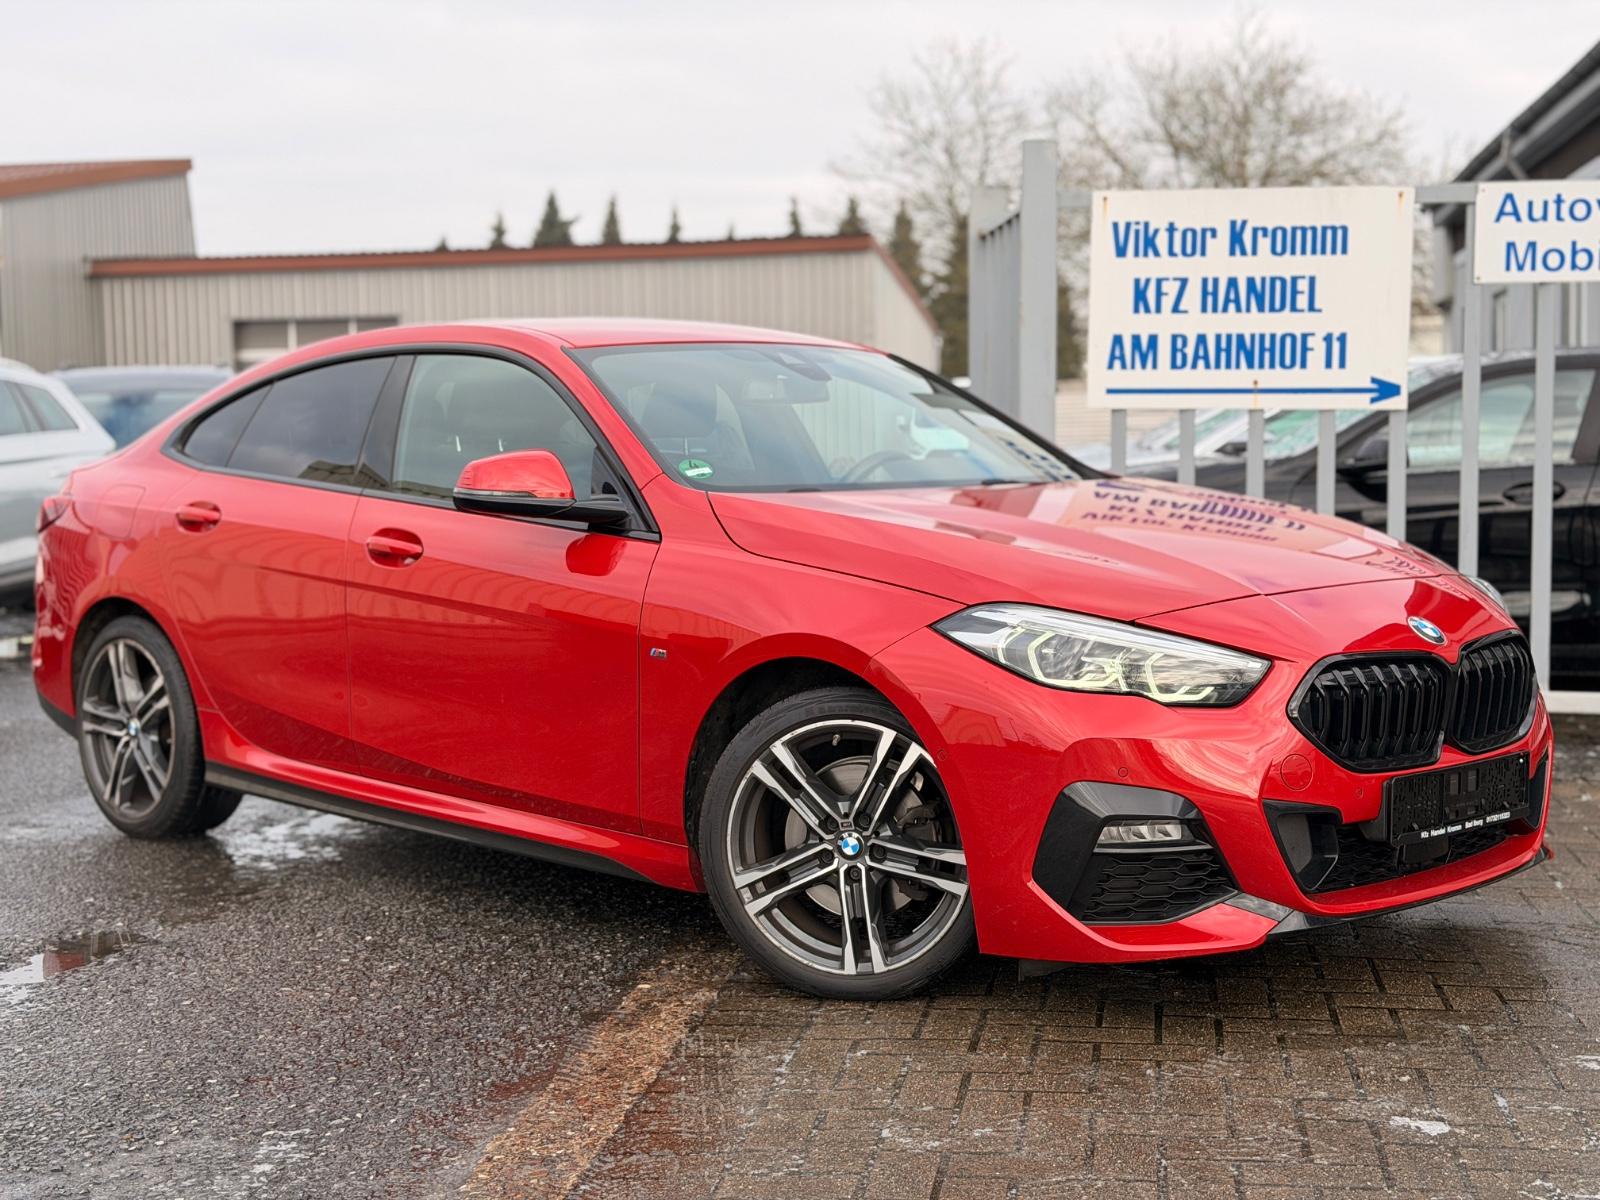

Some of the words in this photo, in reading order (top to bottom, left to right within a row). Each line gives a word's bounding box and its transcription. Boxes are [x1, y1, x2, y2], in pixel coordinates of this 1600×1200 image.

[1112, 221, 1218, 258] Viktor
[1228, 219, 1349, 257] Kromm
[1132, 277, 1189, 314] KFZ
[1199, 275, 1323, 313] HANDEL
[1107, 334, 1159, 370] AM
[1170, 332, 1316, 370] BAHNHOF
[1323, 332, 1348, 370] 11
